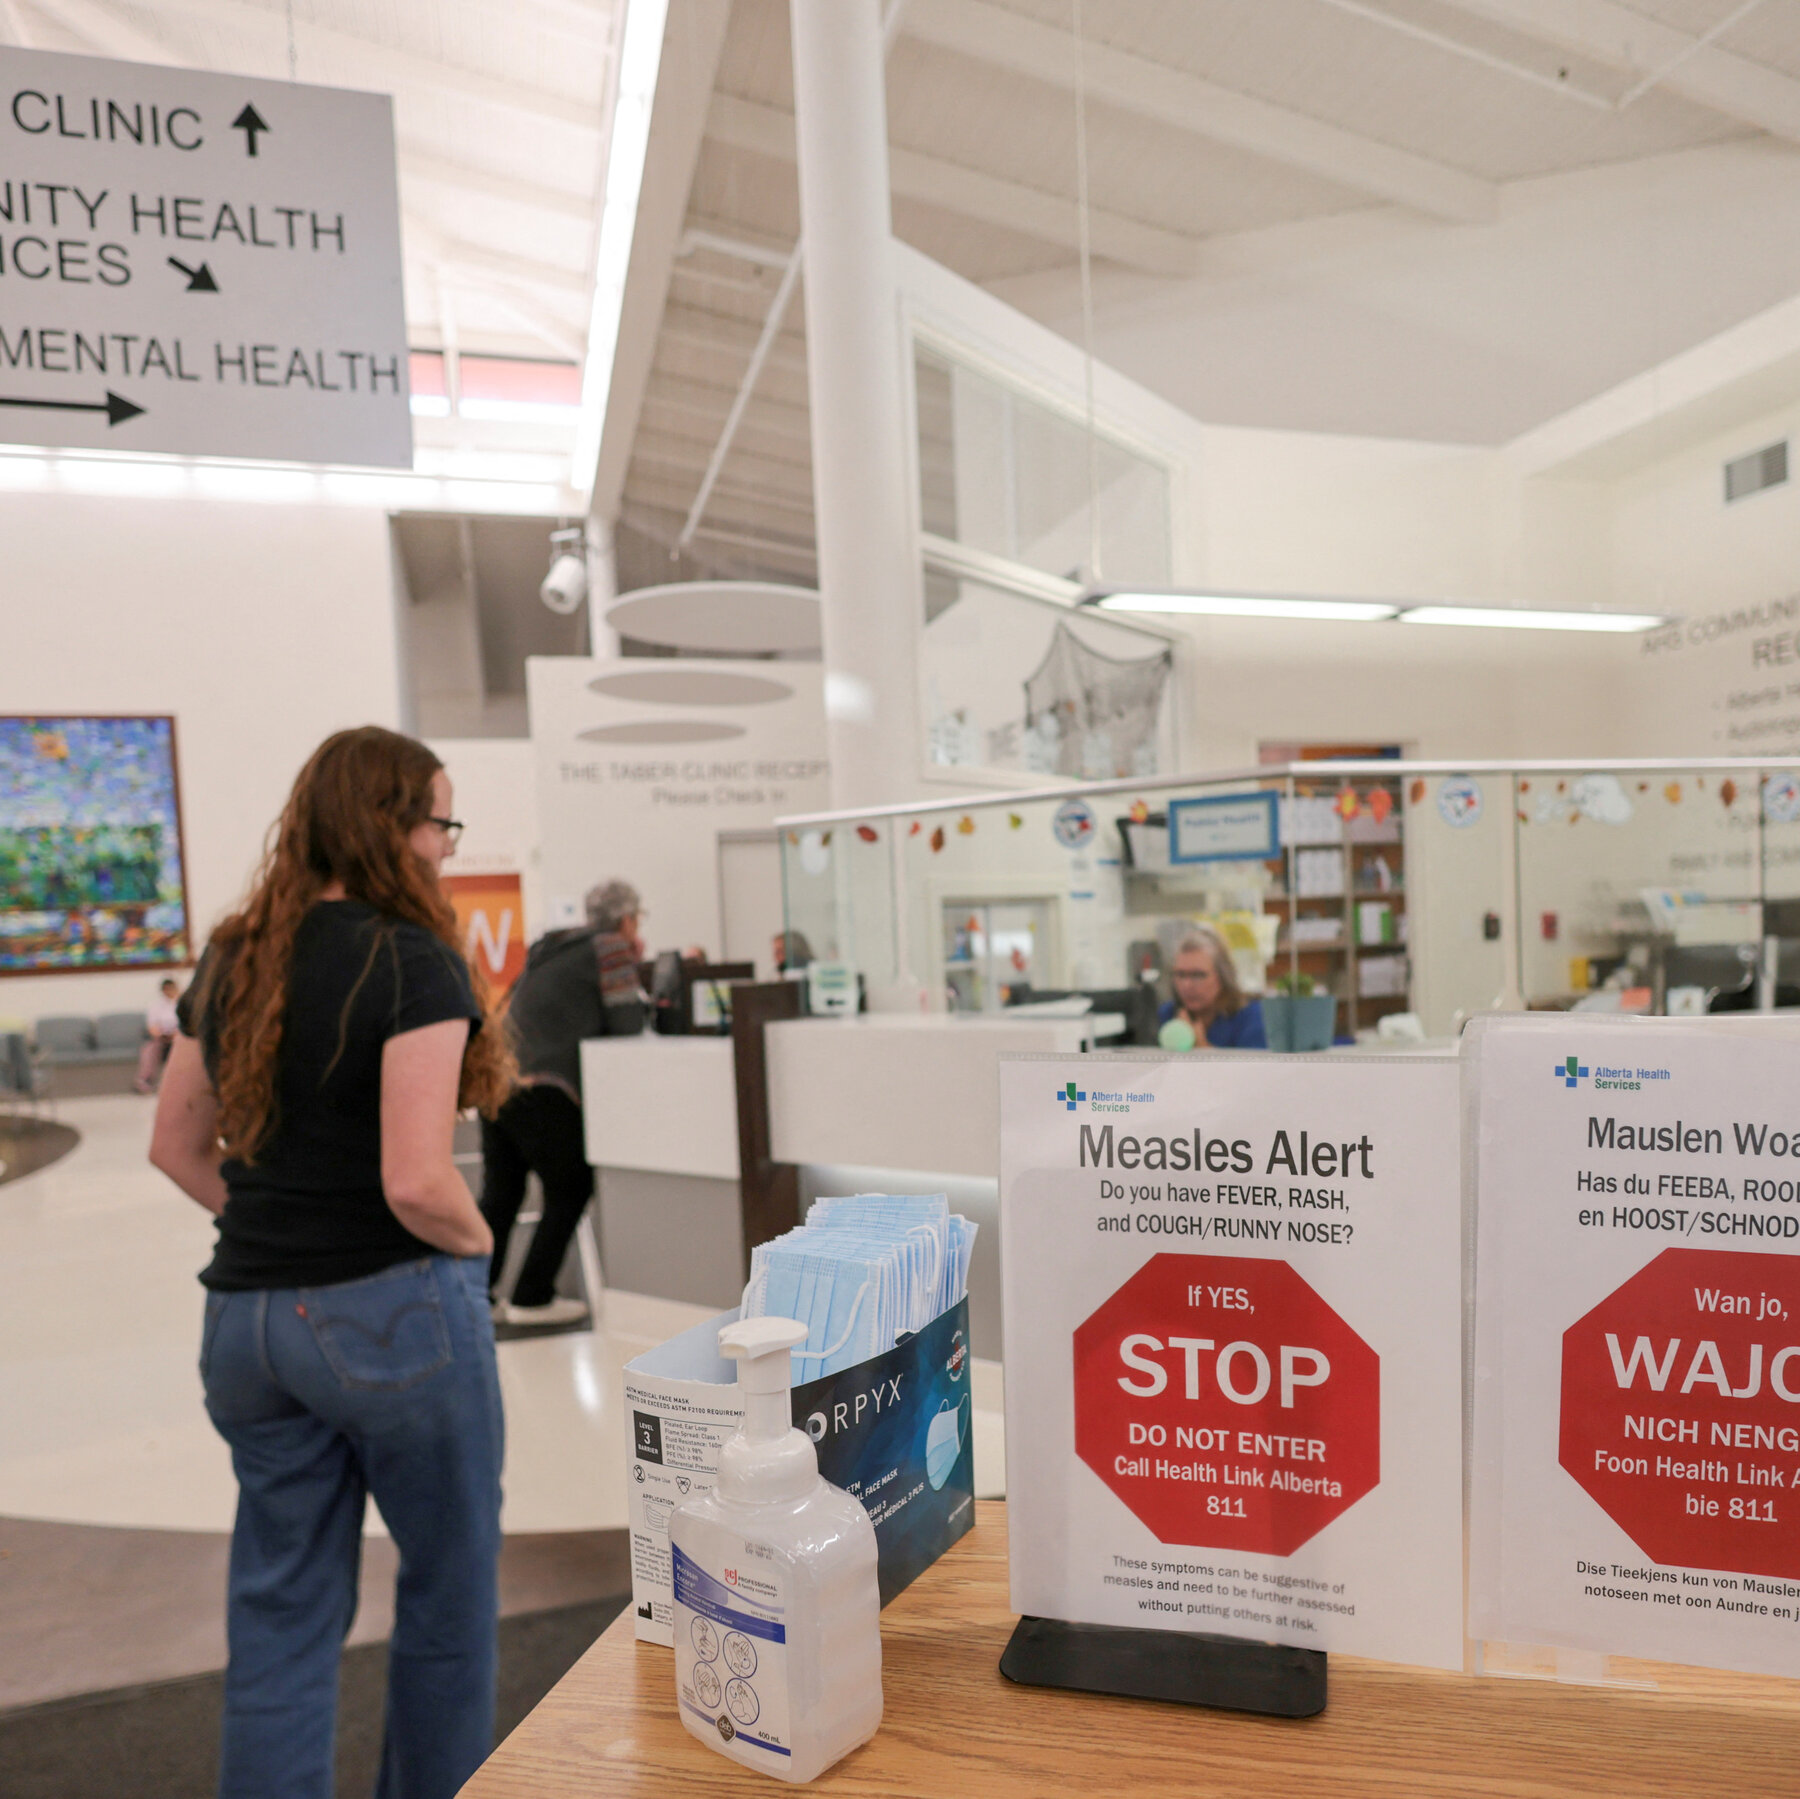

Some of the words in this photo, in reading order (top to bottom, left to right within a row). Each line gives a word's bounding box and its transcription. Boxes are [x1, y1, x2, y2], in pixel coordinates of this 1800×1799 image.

[13, 90, 204, 151] CLINIC
[131, 193, 345, 253] HEALTH
[0, 326, 200, 381] MENTAL
[215, 343, 400, 395] HEALTH
[560, 761, 602, 783] THE
[610, 761, 677, 782] TABER
[681, 760, 748, 781] CLINIC
[652, 786, 710, 804] Please
[714, 785, 765, 804] Check
[1594, 1067, 1632, 1079] Alberta
[1636, 1068, 1670, 1080] Health
[1594, 1078, 1641, 1091] Services
[1091, 1091, 1123, 1102] Alberta
[1125, 1092, 1155, 1103] Health
[1091, 1102, 1130, 1113] Services
[1587, 1117, 1723, 1154] Mauslen
[1079, 1124, 1253, 1173] Measles
[1265, 1130, 1374, 1179] Alert
[1101, 1180, 1125, 1199] Do
[1130, 1185, 1162, 1205] you
[1168, 1182, 1211, 1203] have
[1217, 1185, 1283, 1210] FEVER,
[1289, 1187, 1350, 1213] RASH,
[1577, 1171, 1618, 1194] Has
[1623, 1173, 1650, 1195] du
[1658, 1174, 1735, 1204] FEEBA,
[1743, 1179, 1800, 1203] ROO
[1097, 1213, 1131, 1232] and
[1136, 1215, 1282, 1241] COUGH/RUNNY
[1288, 1222, 1354, 1244] NOSE?
[1578, 1209, 1604, 1226] en
[1613, 1206, 1800, 1238] HOOST/SCHNOD
[1188, 1285, 1202, 1307] If
[1207, 1286, 1255, 1314] YES,
[1694, 1287, 1751, 1314] Wan
[1756, 1292, 1788, 1321] jo,
[1117, 1334, 1330, 1408] STOP
[627, 1393, 640, 1402] MEETS
[648, 1399, 670, 1409] EXCEEDS
[638, 1390, 657, 1399] MEDICAL
[659, 1394, 672, 1402] FACE
[805, 1374, 902, 1443] ORPYX
[639, 1422, 654, 1431] LEVEL
[644, 1431, 651, 1444] 3
[1624, 1415, 1698, 1444] NICH
[1711, 1422, 1799, 1452] NENG
[1129, 1423, 1167, 1447] DO
[1176, 1427, 1230, 1451] NOT
[1238, 1432, 1326, 1463] ENTER
[866, 1480, 880, 1497] FACE
[882, 1468, 898, 1485] MASK
[1114, 1456, 1150, 1478] Call
[1155, 1459, 1217, 1484] Health
[1224, 1464, 1264, 1488] Link
[1270, 1469, 1342, 1498] Alberta
[1595, 1450, 1648, 1476] Foon
[1656, 1455, 1729, 1483] Health
[1737, 1462, 1785, 1488] Link
[643, 1493, 674, 1506] APPLICATION
[883, 1501, 886, 1509] 3
[1206, 1495, 1247, 1518] 811
[1686, 1493, 1720, 1516] bie
[1728, 1497, 1778, 1523] 811
[738, 1576, 777, 1591] PROFESSIONAL
[1113, 1555, 1148, 1572] These
[1151, 1560, 1214, 1577] symptoms
[1217, 1567, 1240, 1580] can
[1243, 1568, 1259, 1581] be
[1262, 1571, 1329, 1593] suggestive
[1332, 1582, 1346, 1596] of
[1577, 1561, 1607, 1576] Dise
[1611, 1564, 1678, 1584] Tieekjens
[1682, 1572, 1709, 1588] kun
[1713, 1577, 1738, 1590] von
[1103, 1573, 1154, 1591] measles
[1157, 1577, 1180, 1592] and
[1183, 1580, 1213, 1594] need
[1217, 1583, 1229, 1596] to
[1232, 1583, 1248, 1598] be
[1251, 1586, 1294, 1606] further
[1296, 1593, 1355, 1617] assessed
[1585, 1584, 1649, 1601] notoseen
[1653, 1593, 1681, 1606] met
[1685, 1596, 1712, 1609] oon
[1716, 1598, 1768, 1616] Aundre
[1773, 1607, 1791, 1619] en
[1138, 1598, 1184, 1614] without
[1187, 1602, 1230, 1620] putting
[1233, 1605, 1272, 1624] others
[1275, 1614, 1288, 1626] at
[1291, 1615, 1318, 1632] risk.
[758, 1730, 770, 1740] 400
[771, 1736, 780, 1744] mL
